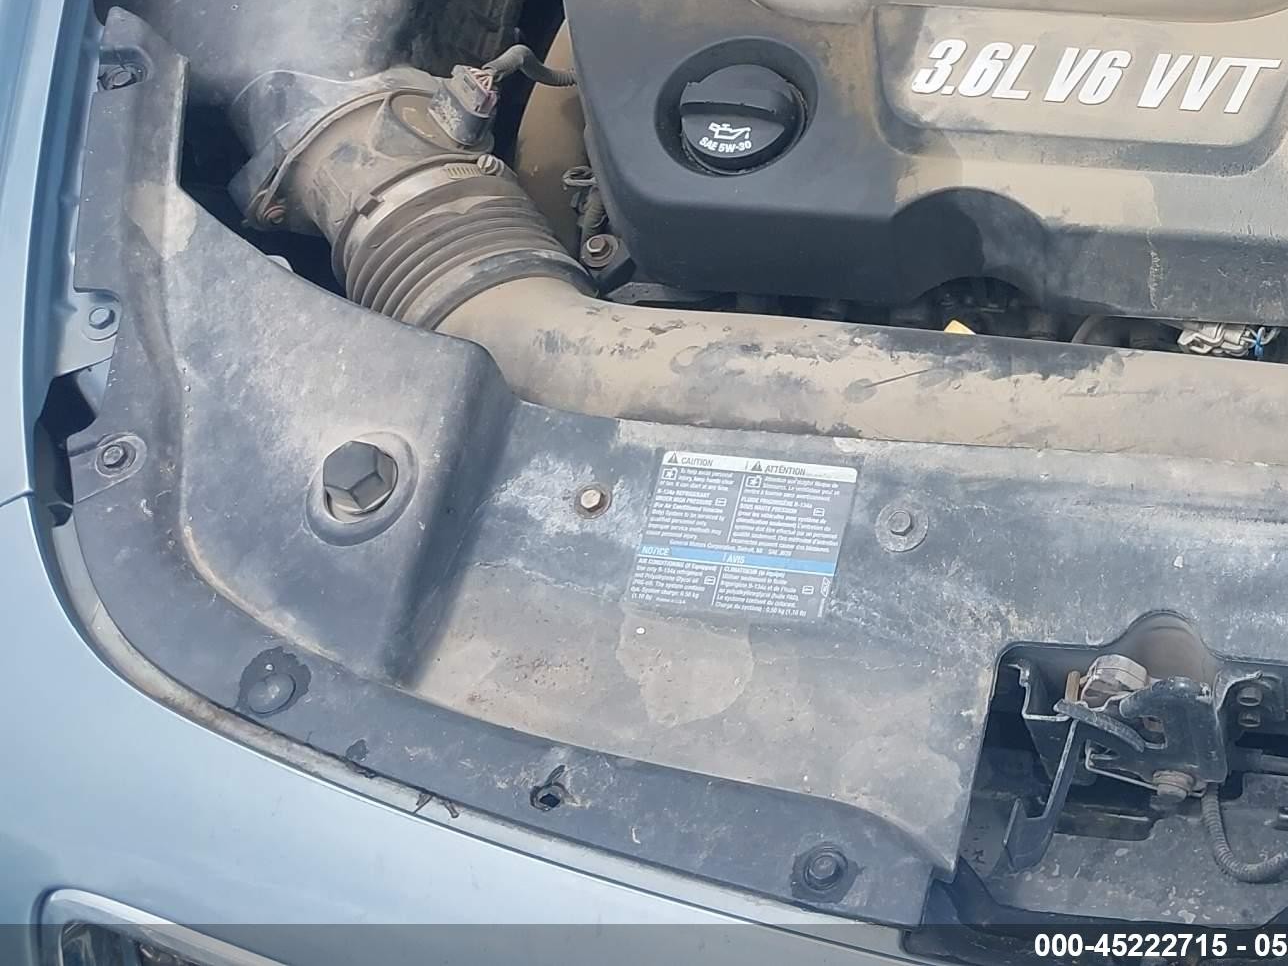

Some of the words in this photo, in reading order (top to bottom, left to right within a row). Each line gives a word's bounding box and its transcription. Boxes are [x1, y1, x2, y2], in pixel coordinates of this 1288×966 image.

[911, 39, 1037, 100] 3.6L
[1043, 47, 1132, 105] V6
[1137, 53, 1282, 114] VVT
[699, 137, 718, 151] SAE
[718, 141, 752, 153] 5W-30
[681, 456, 713, 466] CAUTION
[764, 464, 806, 475] ATTENTION
[641, 546, 670, 556] NOTICE
[726, 554, 745, 564] AVIS
